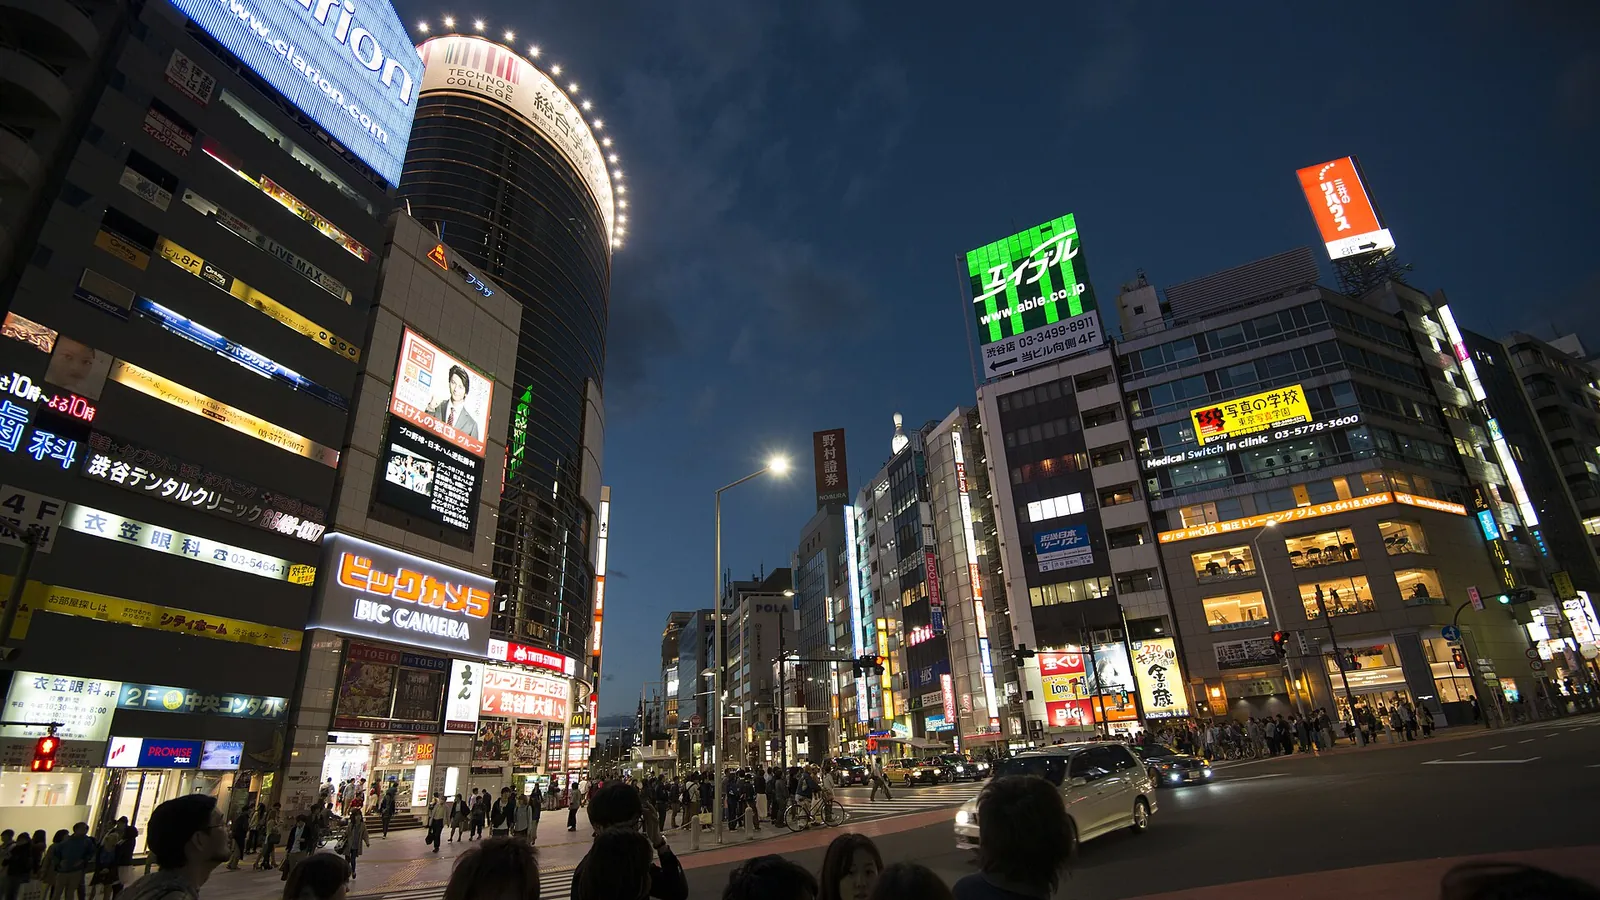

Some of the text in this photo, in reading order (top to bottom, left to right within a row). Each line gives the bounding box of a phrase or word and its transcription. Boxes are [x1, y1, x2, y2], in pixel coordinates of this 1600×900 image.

[296, 0, 414, 106] rion
[219, 0, 389, 144] ww.clarion.com
[448, 68, 514, 94] TECHNOS
[446, 77, 513, 103] COLLEGE
[1334, 178, 1351, 204] 三井の
[1320, 181, 1352, 232] リハウス
[296, 260, 322, 283] MAX
[973, 228, 1079, 303] エイブル
[466, 272, 495, 297] プラザ
[980, 282, 1086, 325] www.able.co.jp
[986, 316, 1094, 358] 渋谷店 03-3499-8911
[1021, 331, 1097, 362] 当ビル向側 4F
[224, 342, 279, 375] アパマンショップ
[1224, 389, 1300, 418] 写真の学校
[1238, 406, 1291, 426] 東京写真学園
[457, 435, 484, 453] グループ
[1147, 454, 1186, 469] Medical
[1188, 444, 1224, 460] Switch
[1226, 441, 1238, 453] in
[1239, 435, 1269, 450] clinic
[1274, 414, 1359, 440] 03-5778-3600
[822, 433, 840, 487] 野村證券
[87, 453, 262, 521] 渋谷デンタルクリニック
[818, 491, 848, 502] NOMURA
[1040, 529, 1077, 543] 近畿日本
[1041, 535, 1083, 550] ツーリスト
[337, 551, 491, 619] ビックカメラ
[48, 594, 108, 613] お部屋探しは
[755, 603, 789, 614] POLA
[160, 612, 228, 636] シティホーム
[354, 598, 470, 641] BIC CAMERA
[233, 626, 277, 642] 渋谷センター
[1131, 642, 1142, 650] 1F
[1143, 644, 1162, 655] 270
[1042, 655, 1080, 670] 宝くじ
[34, 676, 116, 698] 衣笠眼科 4F
[124, 687, 159, 707] 2F
[1147, 664, 1174, 708] 金の蔵
[185, 691, 287, 718] 中央コンタクト
[1055, 706, 1085, 720] BIG
[148, 746, 192, 758] PROMISE
[417, 743, 434, 755] BIC
